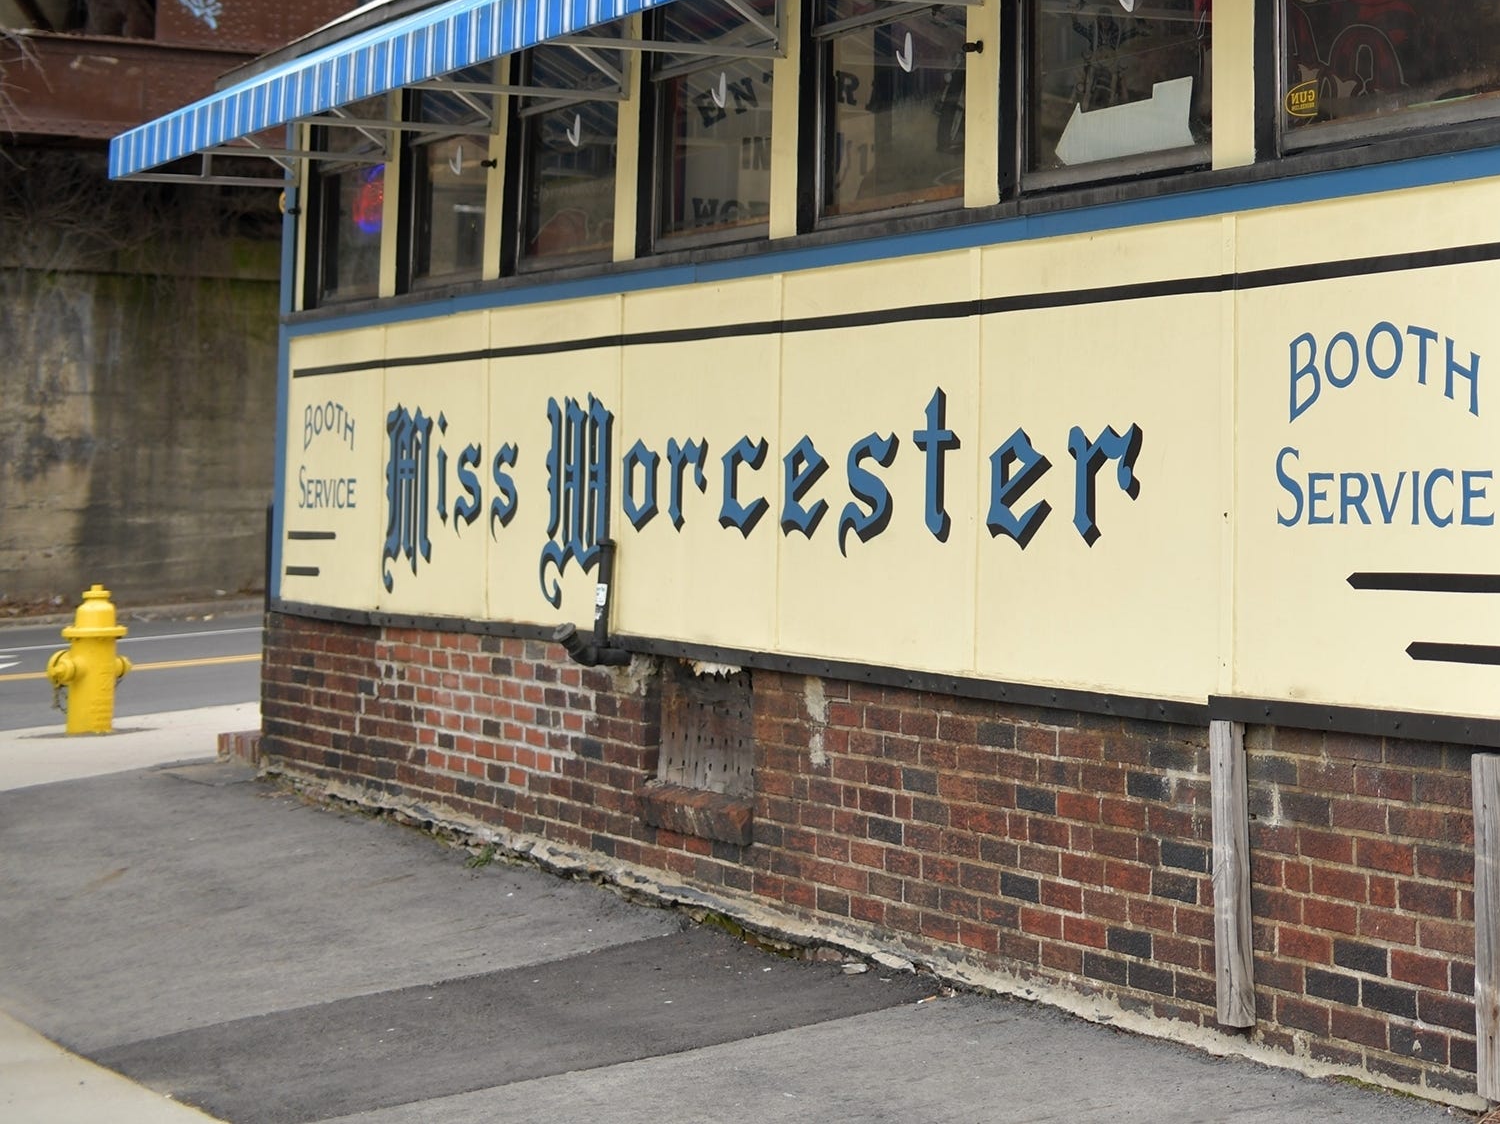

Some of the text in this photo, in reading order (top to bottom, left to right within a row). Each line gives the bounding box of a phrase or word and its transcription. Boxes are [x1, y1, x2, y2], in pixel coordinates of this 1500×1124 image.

[1288, 320, 1481, 424] BOOTH
[303, 400, 356, 452] BOOTH
[298, 464, 357, 511] SERVICE
[382, 386, 1143, 610] Miss Worcester
[1275, 446, 1495, 528] SERVICE
